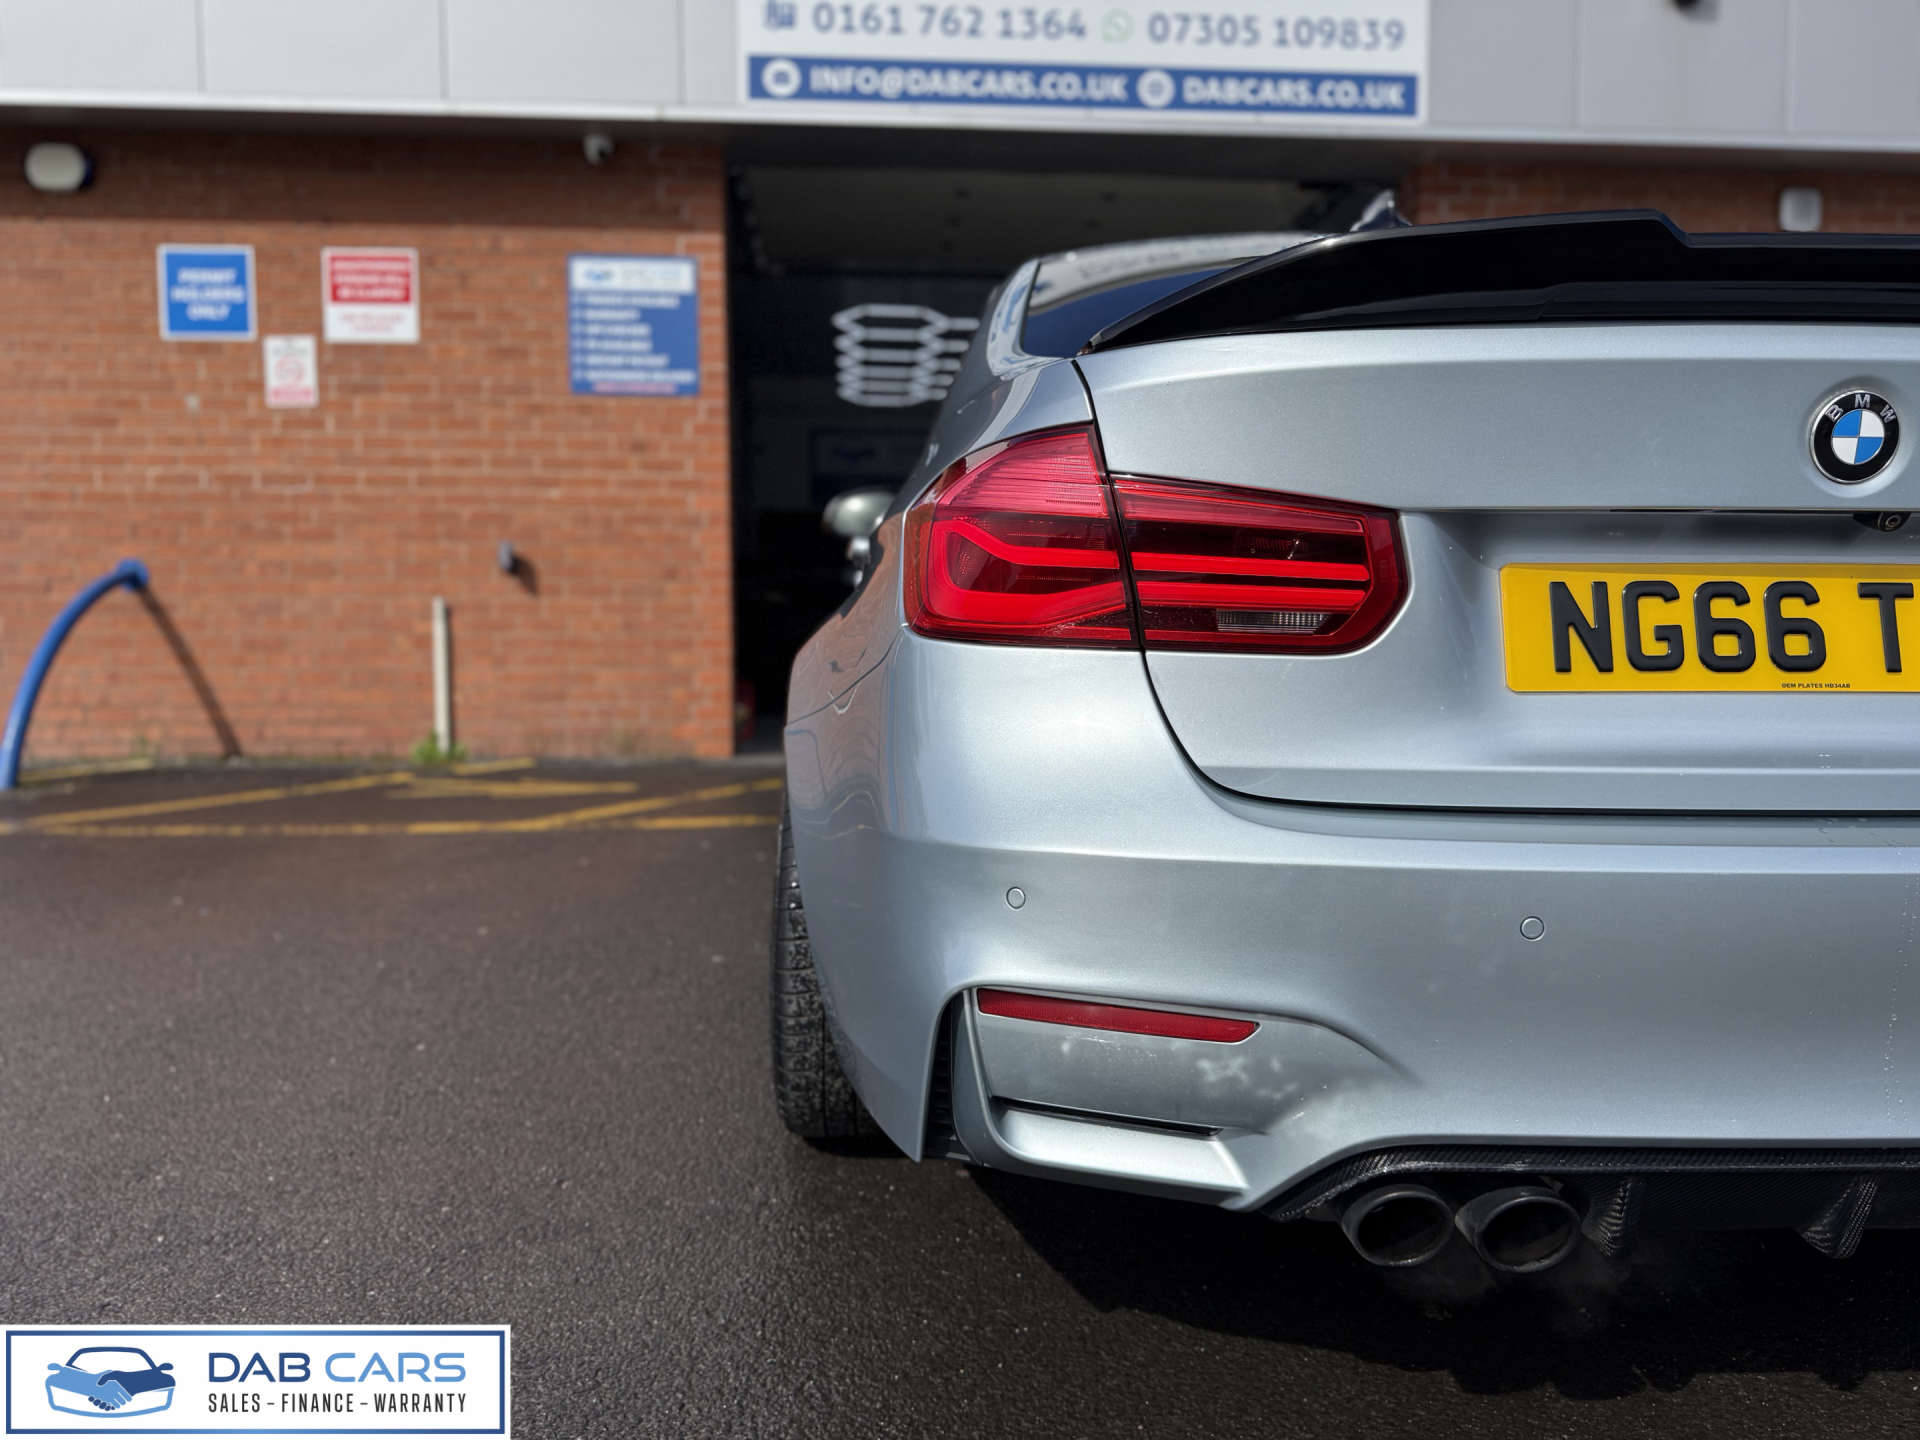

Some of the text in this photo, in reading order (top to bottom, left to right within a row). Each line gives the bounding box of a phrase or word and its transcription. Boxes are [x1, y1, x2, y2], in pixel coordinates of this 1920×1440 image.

[811, 1, 1406, 51] 0161 762 1364 07305 109839
[810, 66, 1406, 108] INFO@DABCARS.CO.UK DABCARS.CO.UK
[1825, 393, 1897, 423] BMW
[1549, 581, 1914, 673] NG66 T
